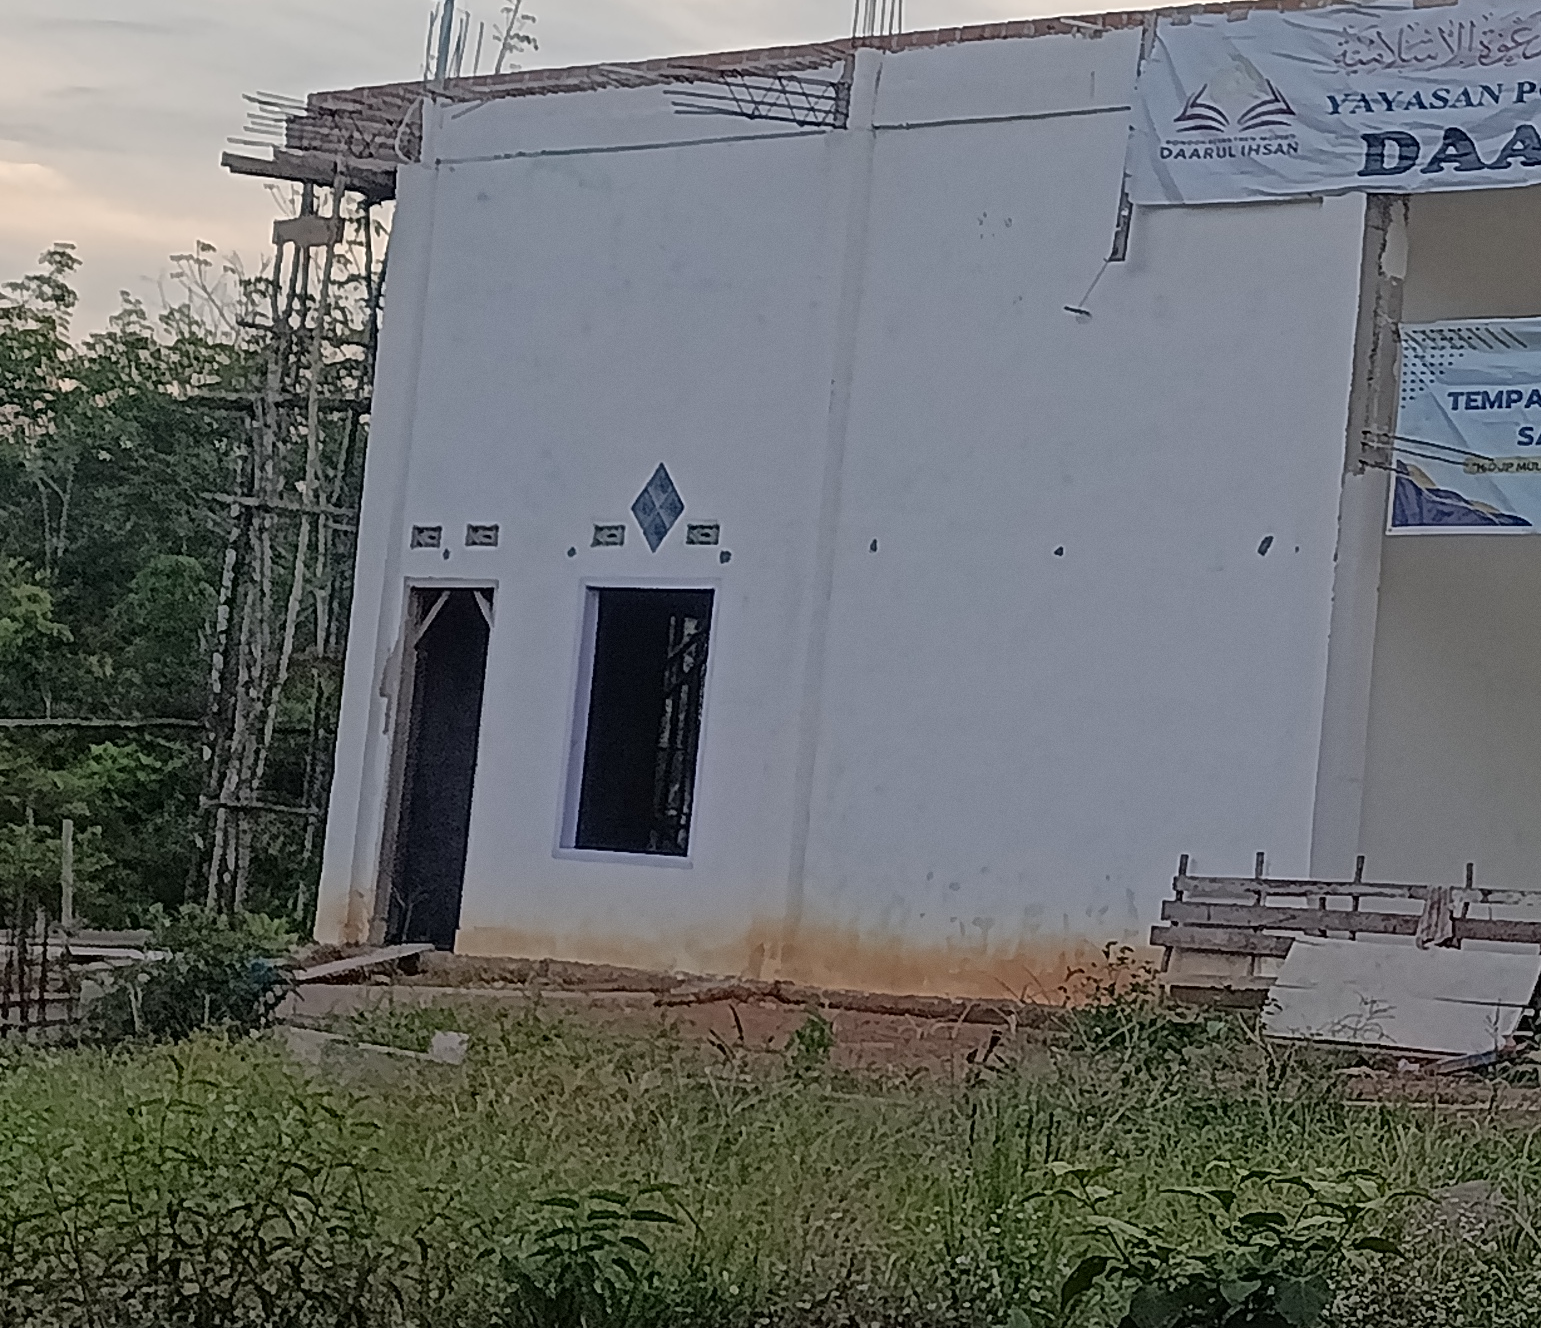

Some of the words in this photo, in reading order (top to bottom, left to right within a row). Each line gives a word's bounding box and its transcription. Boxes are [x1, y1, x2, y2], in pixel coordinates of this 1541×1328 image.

[1326, 82, 1503, 115] YAYASAN
[1160, 145, 1236, 160] DAARUL
[1240, 141, 1299, 157] IHSAN
